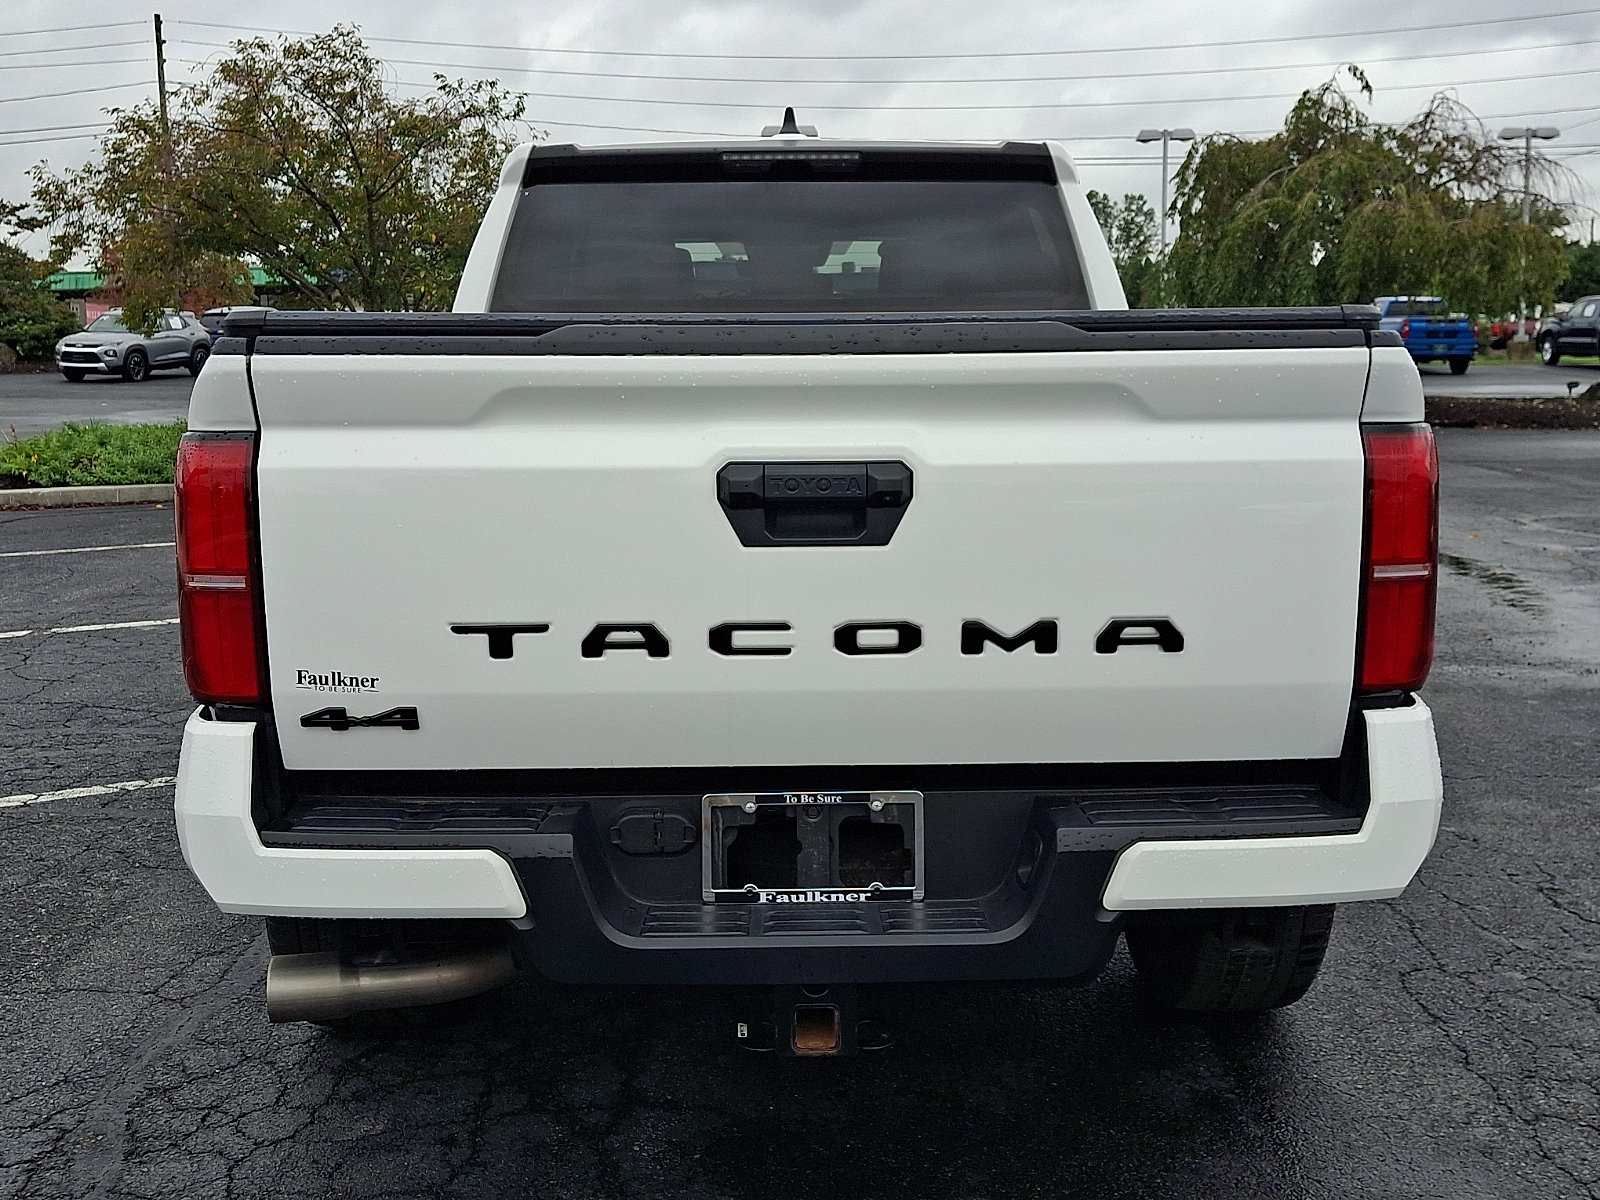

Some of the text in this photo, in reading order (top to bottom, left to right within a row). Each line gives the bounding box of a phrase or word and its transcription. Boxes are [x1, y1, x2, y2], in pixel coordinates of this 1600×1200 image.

[769, 477, 864, 496] TOYOTA
[449, 616, 1185, 660] TACOMA
[296, 669, 380, 689] Faulkner
[783, 793, 843, 804] To Be Sure
[758, 891, 872, 903] Faulkner
